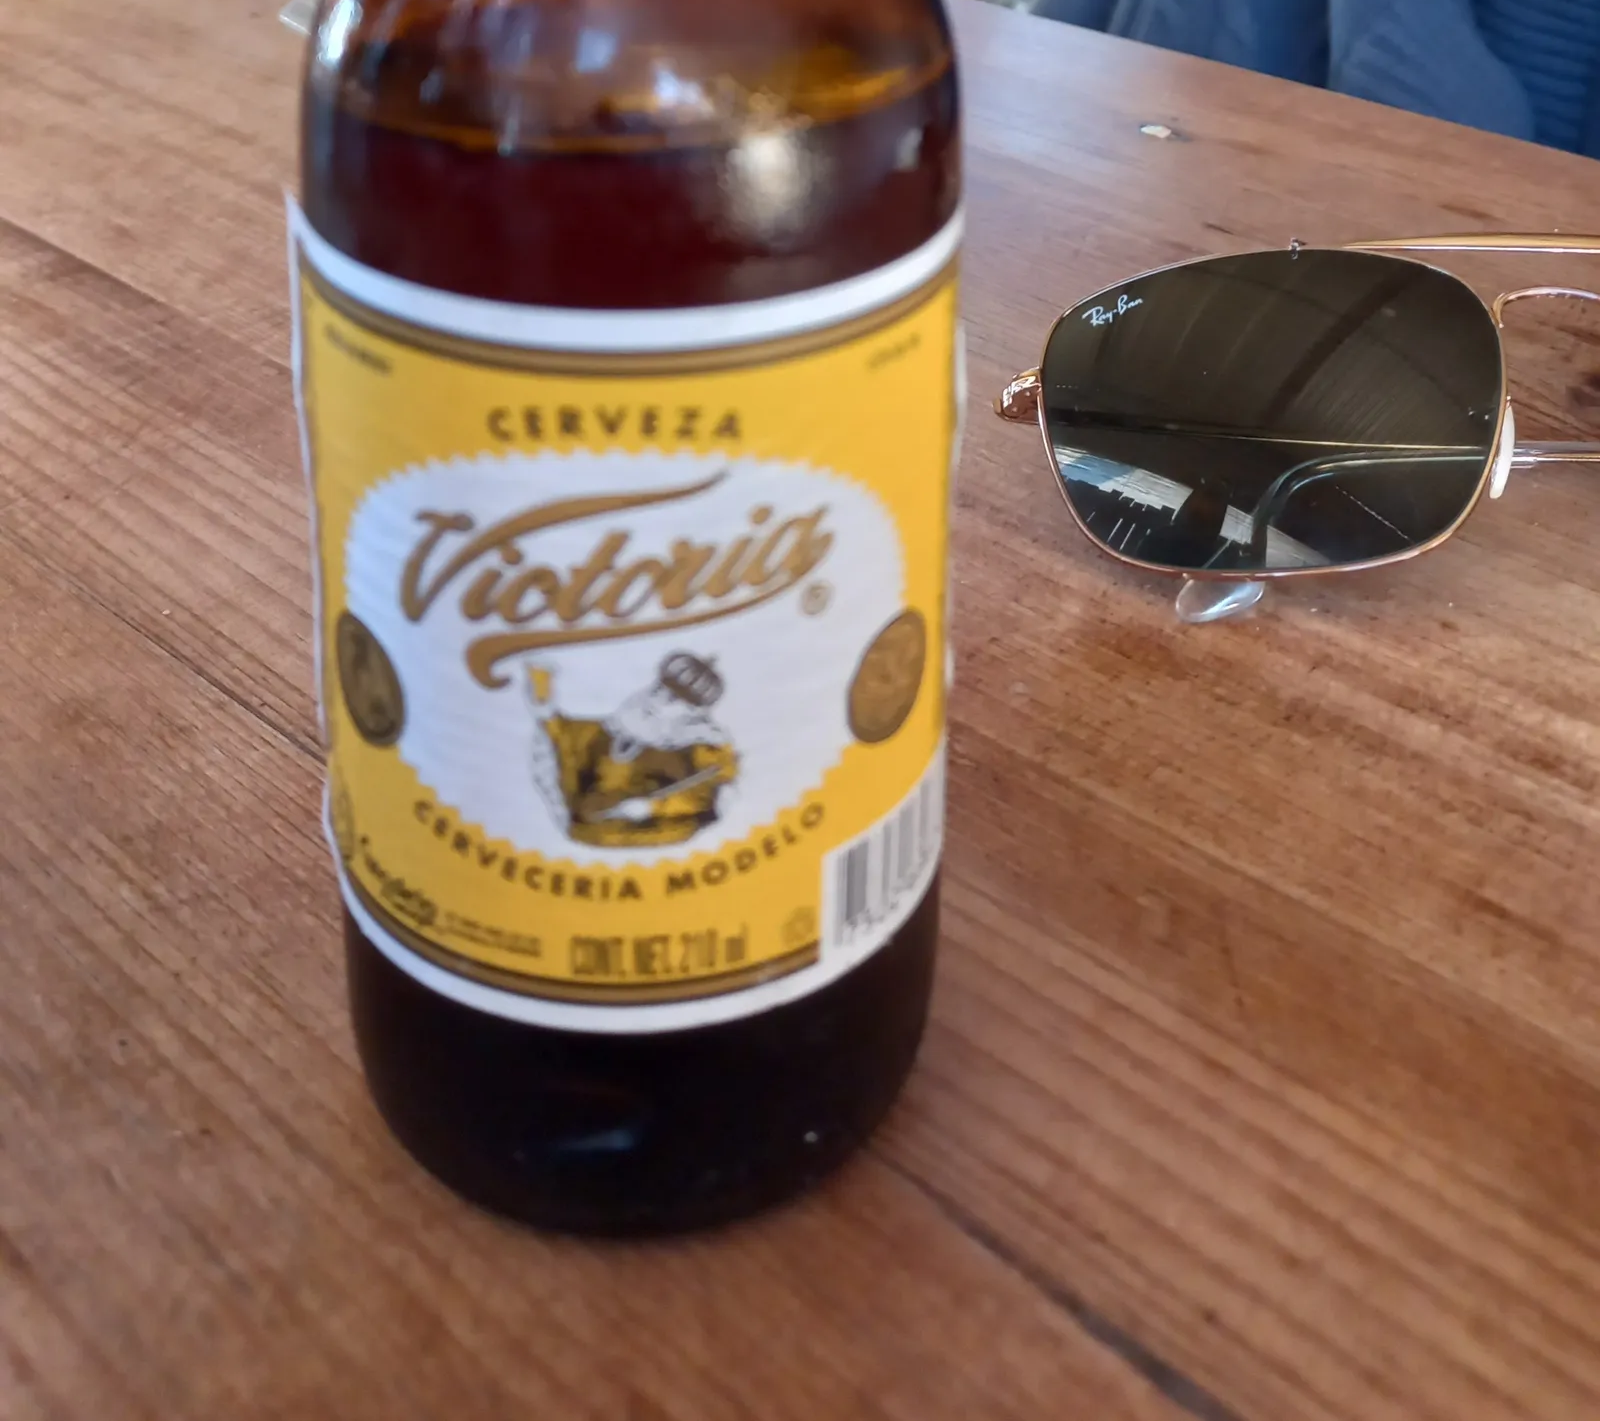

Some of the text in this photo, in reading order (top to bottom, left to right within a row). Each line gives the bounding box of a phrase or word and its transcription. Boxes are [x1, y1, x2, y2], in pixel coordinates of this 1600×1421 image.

[1081, 294, 1143, 327] Ray-Ban
[485, 405, 743, 443] CERVEZA
[400, 468, 834, 628] Victoria
[413, 799, 643, 901] CERVECERIA
[664, 801, 825, 896] MODELO
